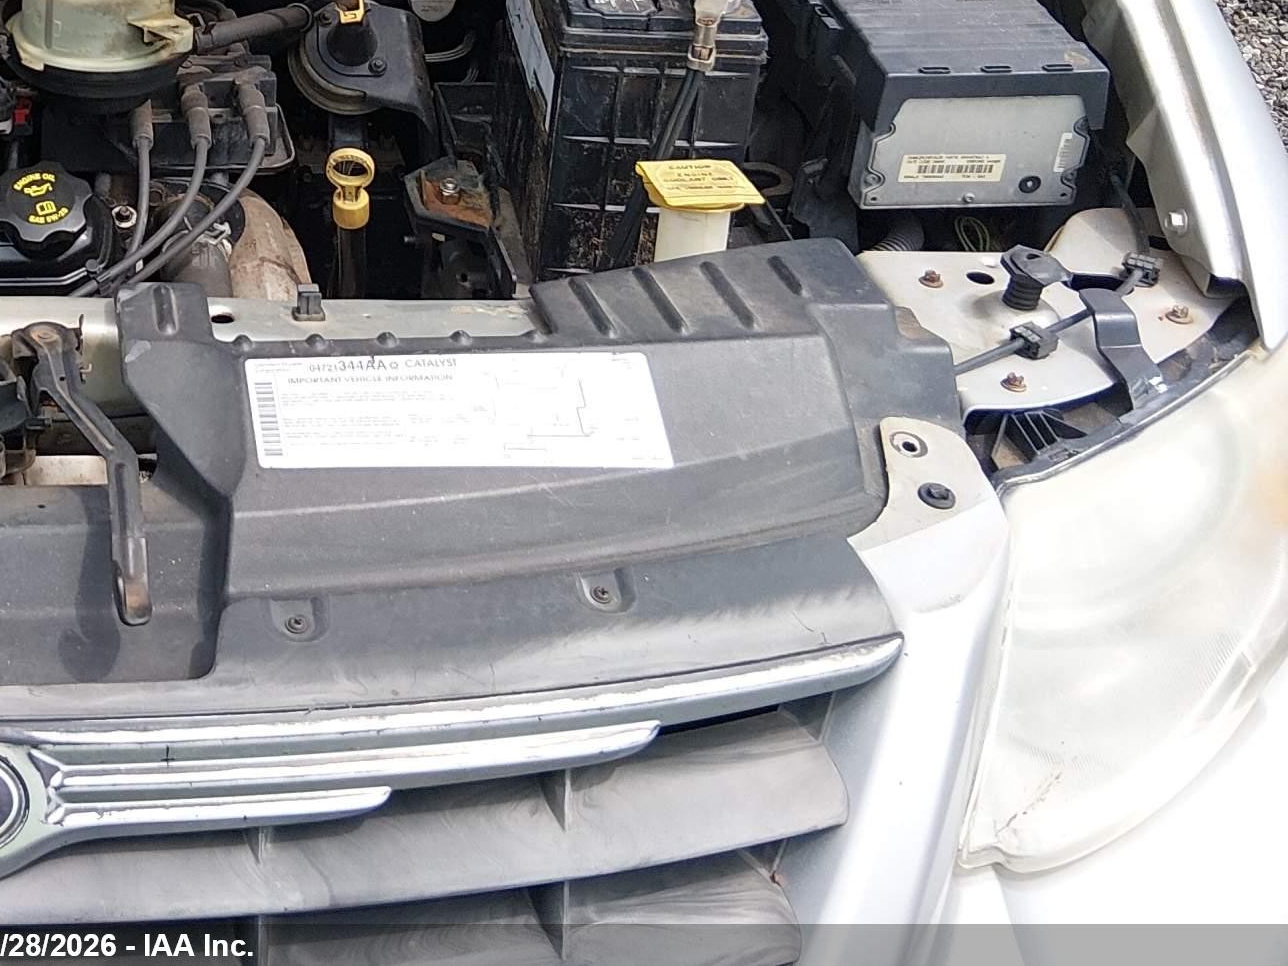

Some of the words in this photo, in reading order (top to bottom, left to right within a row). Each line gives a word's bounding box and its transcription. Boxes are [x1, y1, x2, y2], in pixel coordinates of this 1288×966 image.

[13, 173, 41, 191] ENGINE
[42, 173, 55, 182] OIL
[405, 358, 457, 368] CATALYST
[288, 376, 342, 384] IMPORTANT
[344, 375, 382, 383] VEHICLE
[385, 374, 454, 382] INFORMATION
